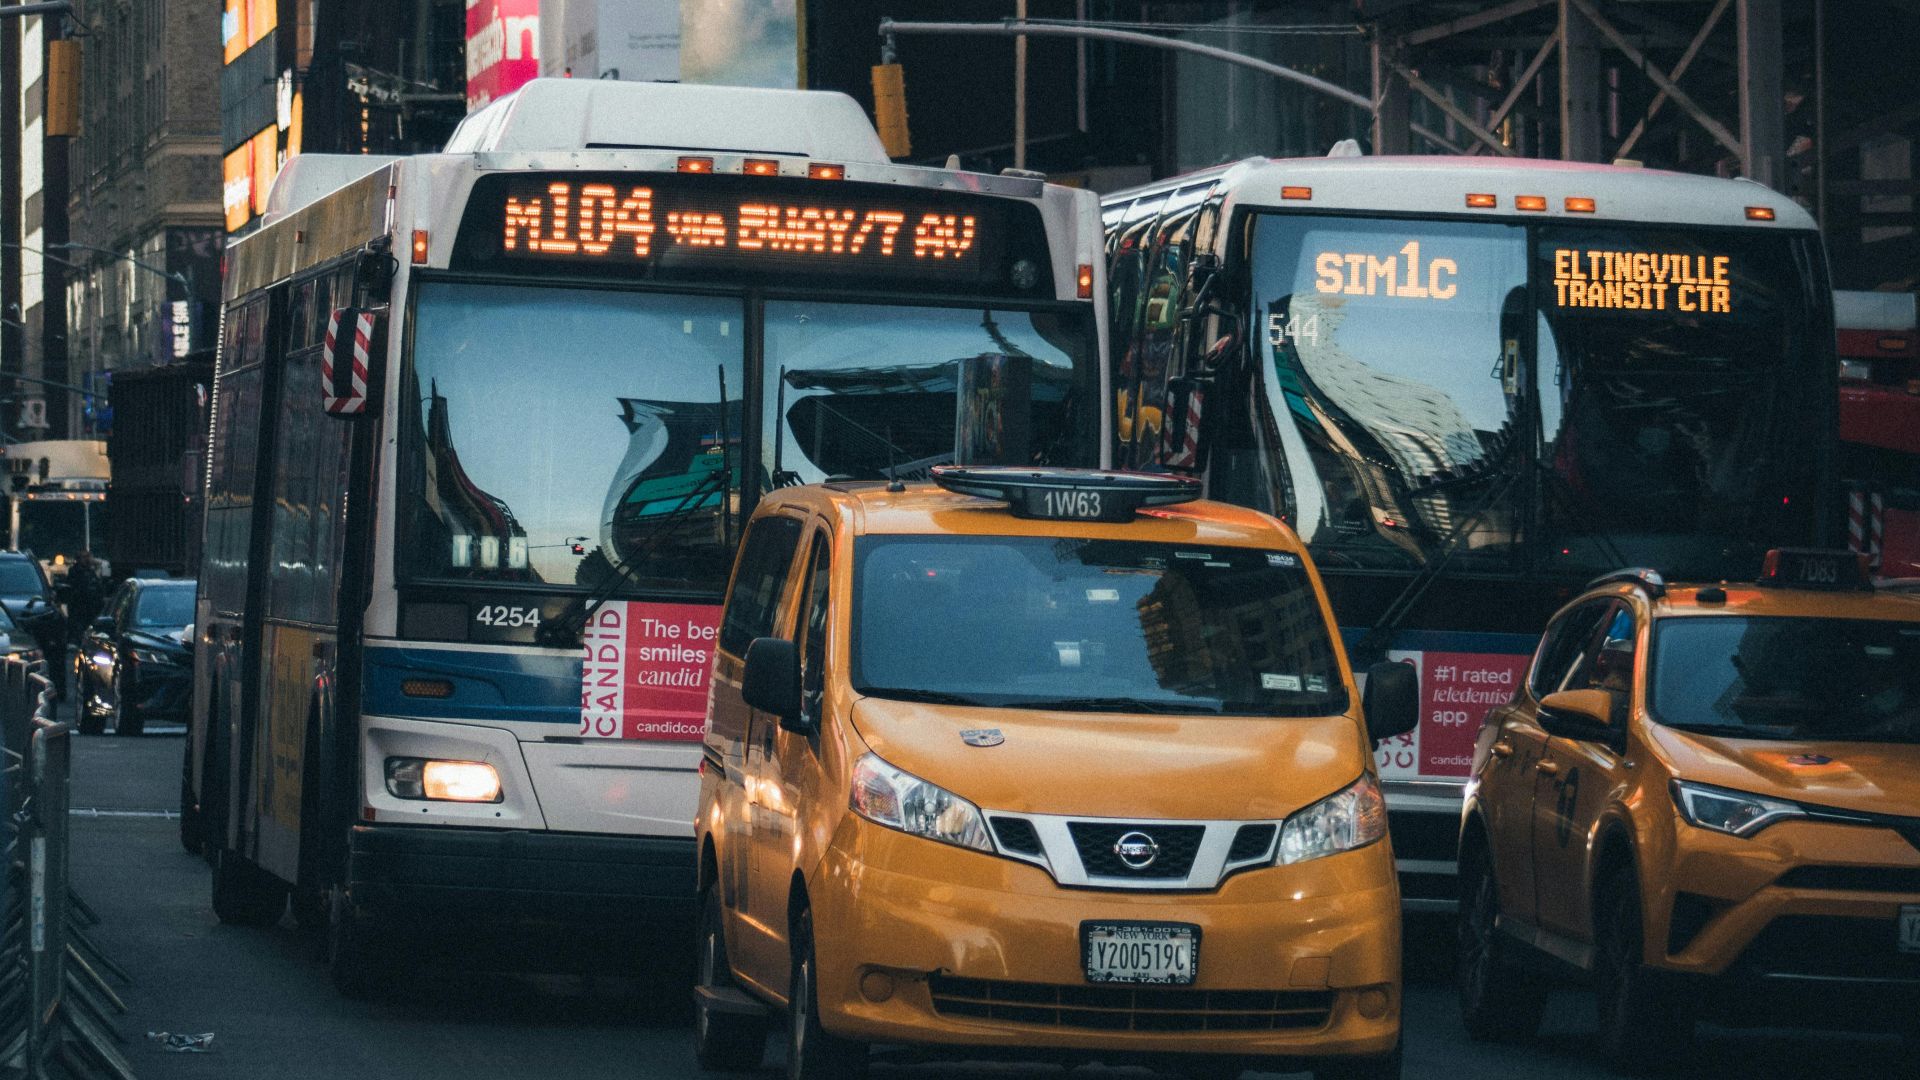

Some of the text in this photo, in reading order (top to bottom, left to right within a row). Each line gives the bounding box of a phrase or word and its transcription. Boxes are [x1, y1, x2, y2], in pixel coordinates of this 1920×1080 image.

[504, 183, 654, 256] M104
[738, 203, 904, 256] BWAY/7
[915, 212, 976, 260] AV
[1554, 248, 1730, 286] ELTINGVILLE
[1553, 279, 1731, 313] TRANSIT CTR
[1267, 312, 1319, 347] 544
[1044, 490, 1101, 518] 1W63
[476, 605, 541, 628] 4254
[641, 618, 681, 639] The
[640, 643, 706, 664] smiles
[596, 608, 621, 737] CANDID
[638, 667, 703, 687] candid
[1433, 665, 1512, 684] #1 rated
[1432, 710, 1468, 728] app
[1115, 930, 1169, 941] NEW YORK
[1097, 941, 1185, 971] Y200519C
